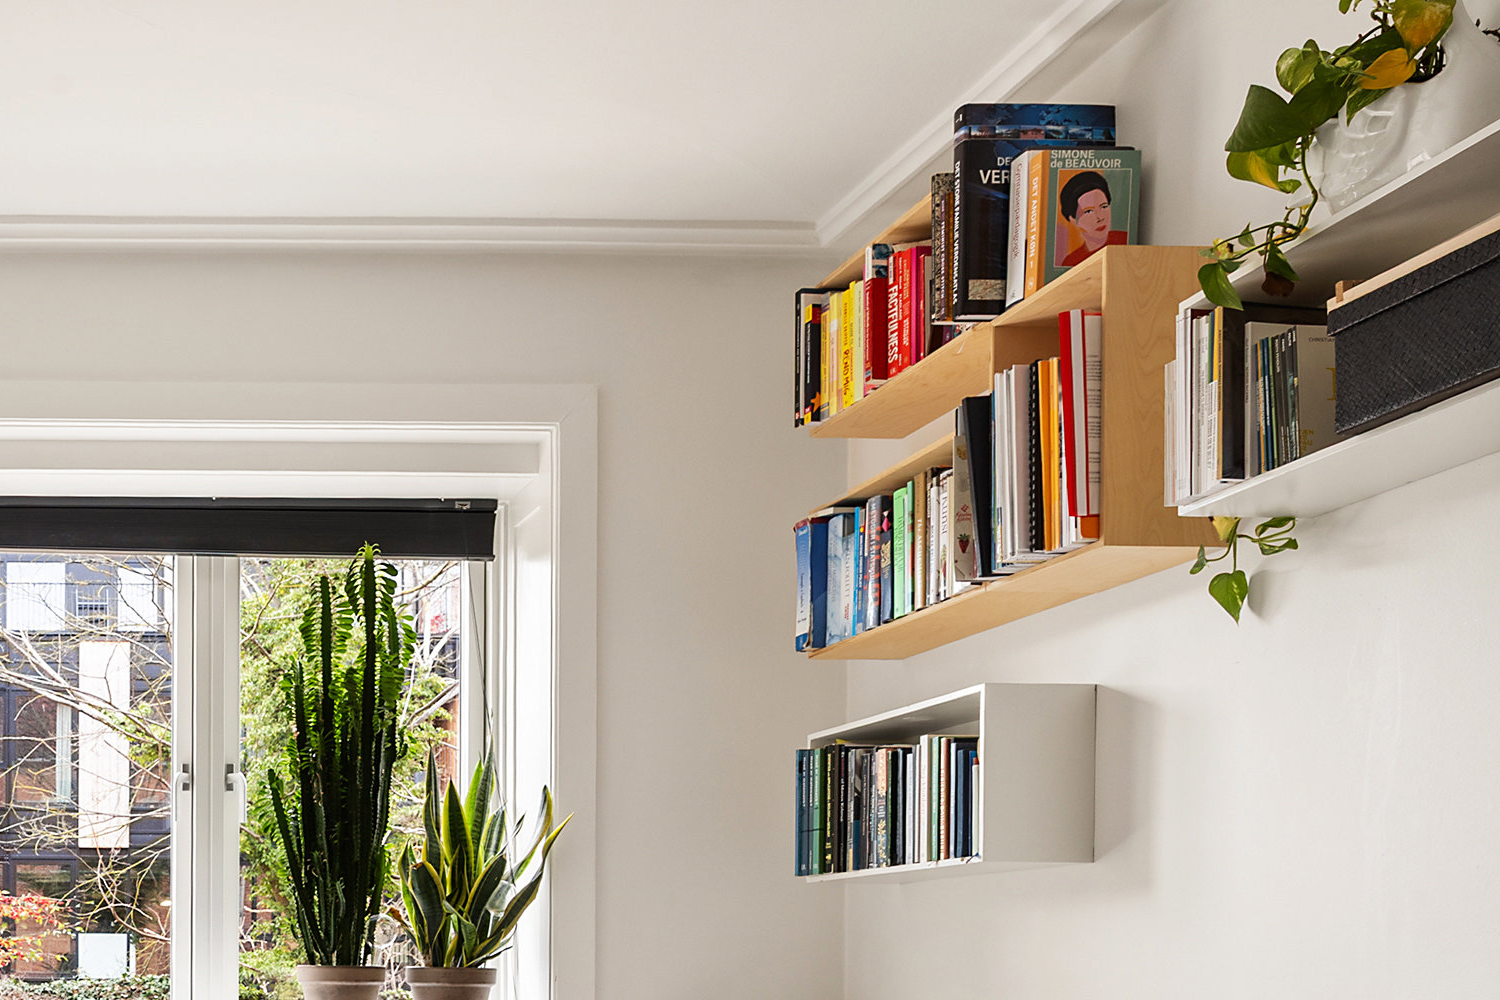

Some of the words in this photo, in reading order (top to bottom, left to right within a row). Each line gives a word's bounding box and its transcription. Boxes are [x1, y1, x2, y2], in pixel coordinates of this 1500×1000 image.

[997, 157, 1012, 166] DE
[1051, 150, 1095, 159] SIMONE
[1051, 159, 1063, 168] de
[1065, 159, 1122, 168] BEAUVOIR
[1031, 176, 1039, 197] DET
[1030, 200, 1038, 233] ANDET
[1029, 235, 1037, 258] KØN
[888, 284, 898, 364] FACTFULNESS
